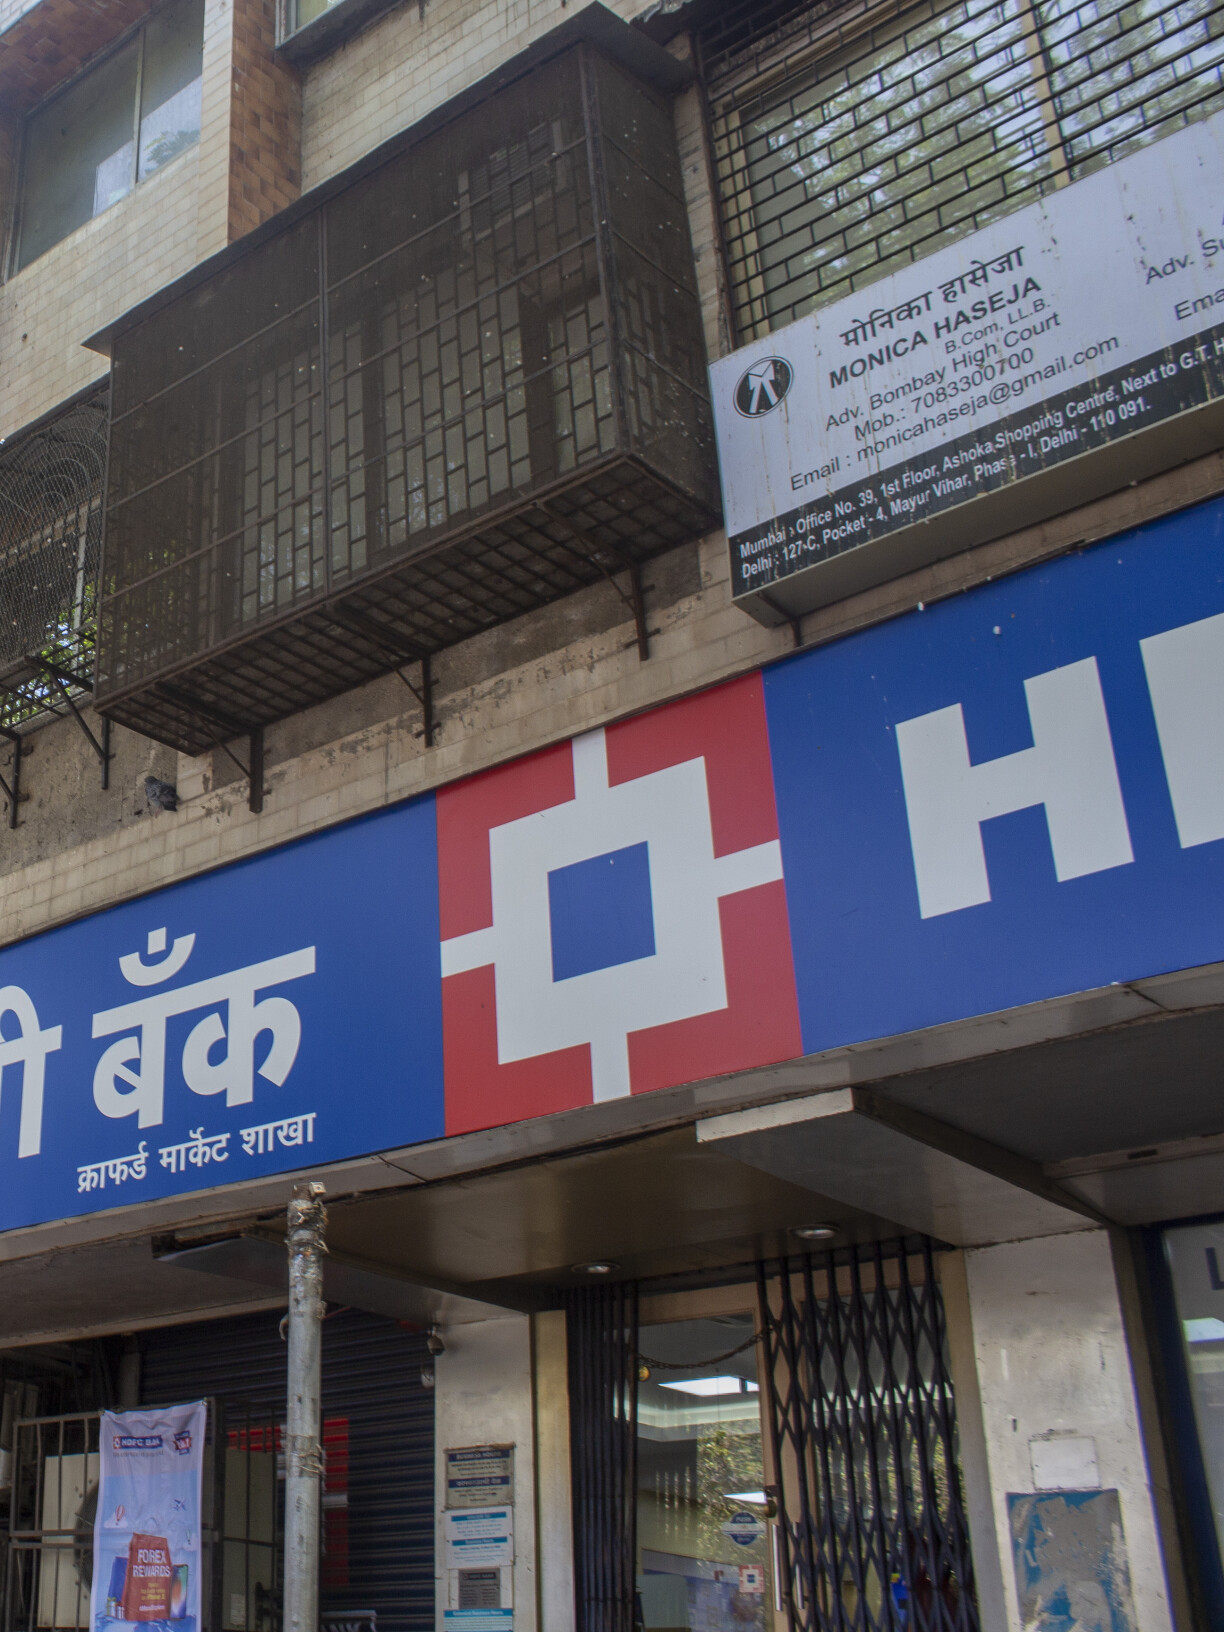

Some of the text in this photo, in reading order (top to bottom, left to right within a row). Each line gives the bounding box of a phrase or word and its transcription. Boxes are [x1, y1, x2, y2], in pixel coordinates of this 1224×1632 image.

[839, 245, 1024, 346] मोनिका हासेजा
[1146, 255, 1195, 285] Adv.
[829, 276, 1041, 388] MONICA HASEJA
[944, 298, 1050, 354] B.Com, LL.B.
[825, 312, 1060, 431] Adv. Bombay High Court
[910, 347, 1033, 413] 7083300700
[740, 527, 786, 558] Mumbai
[795, 510, 831, 533] Office
[834, 500, 856, 517] No.
[858, 488, 877, 506] 39,
[879, 478, 900, 497] 1st
[901, 464, 939, 488] Floor,
[942, 441, 993, 471] Ashoka
[994, 411, 1063, 448] Shopping
[1121, 368, 1158, 394] Next
[1159, 364, 1177, 378] to
[1179, 344, 1212, 369] G.T.
[790, 456, 839, 490] Email
[856, 336, 1118, 461] monicahaseja@gmail.com
[742, 556, 772, 578] Delhi
[822, 515, 865, 544] Pocket
[875, 506, 887, 521] 4,
[889, 489, 930, 515] Mayur
[931, 473, 971, 496] Vihar,
[1039, 424, 1077, 454] Delhi
[1089, 409, 1115, 431] 110
[1118, 396, 1150, 419] 091.
[77, 1140, 148, 1193] क्राफर्ड
[240, 1112, 317, 1157] शाखा
[121, 1438, 143, 1447] HDFC
[132, 1565, 171, 1578] REWARDS
[137, 1549, 167, 1564] FOREX
